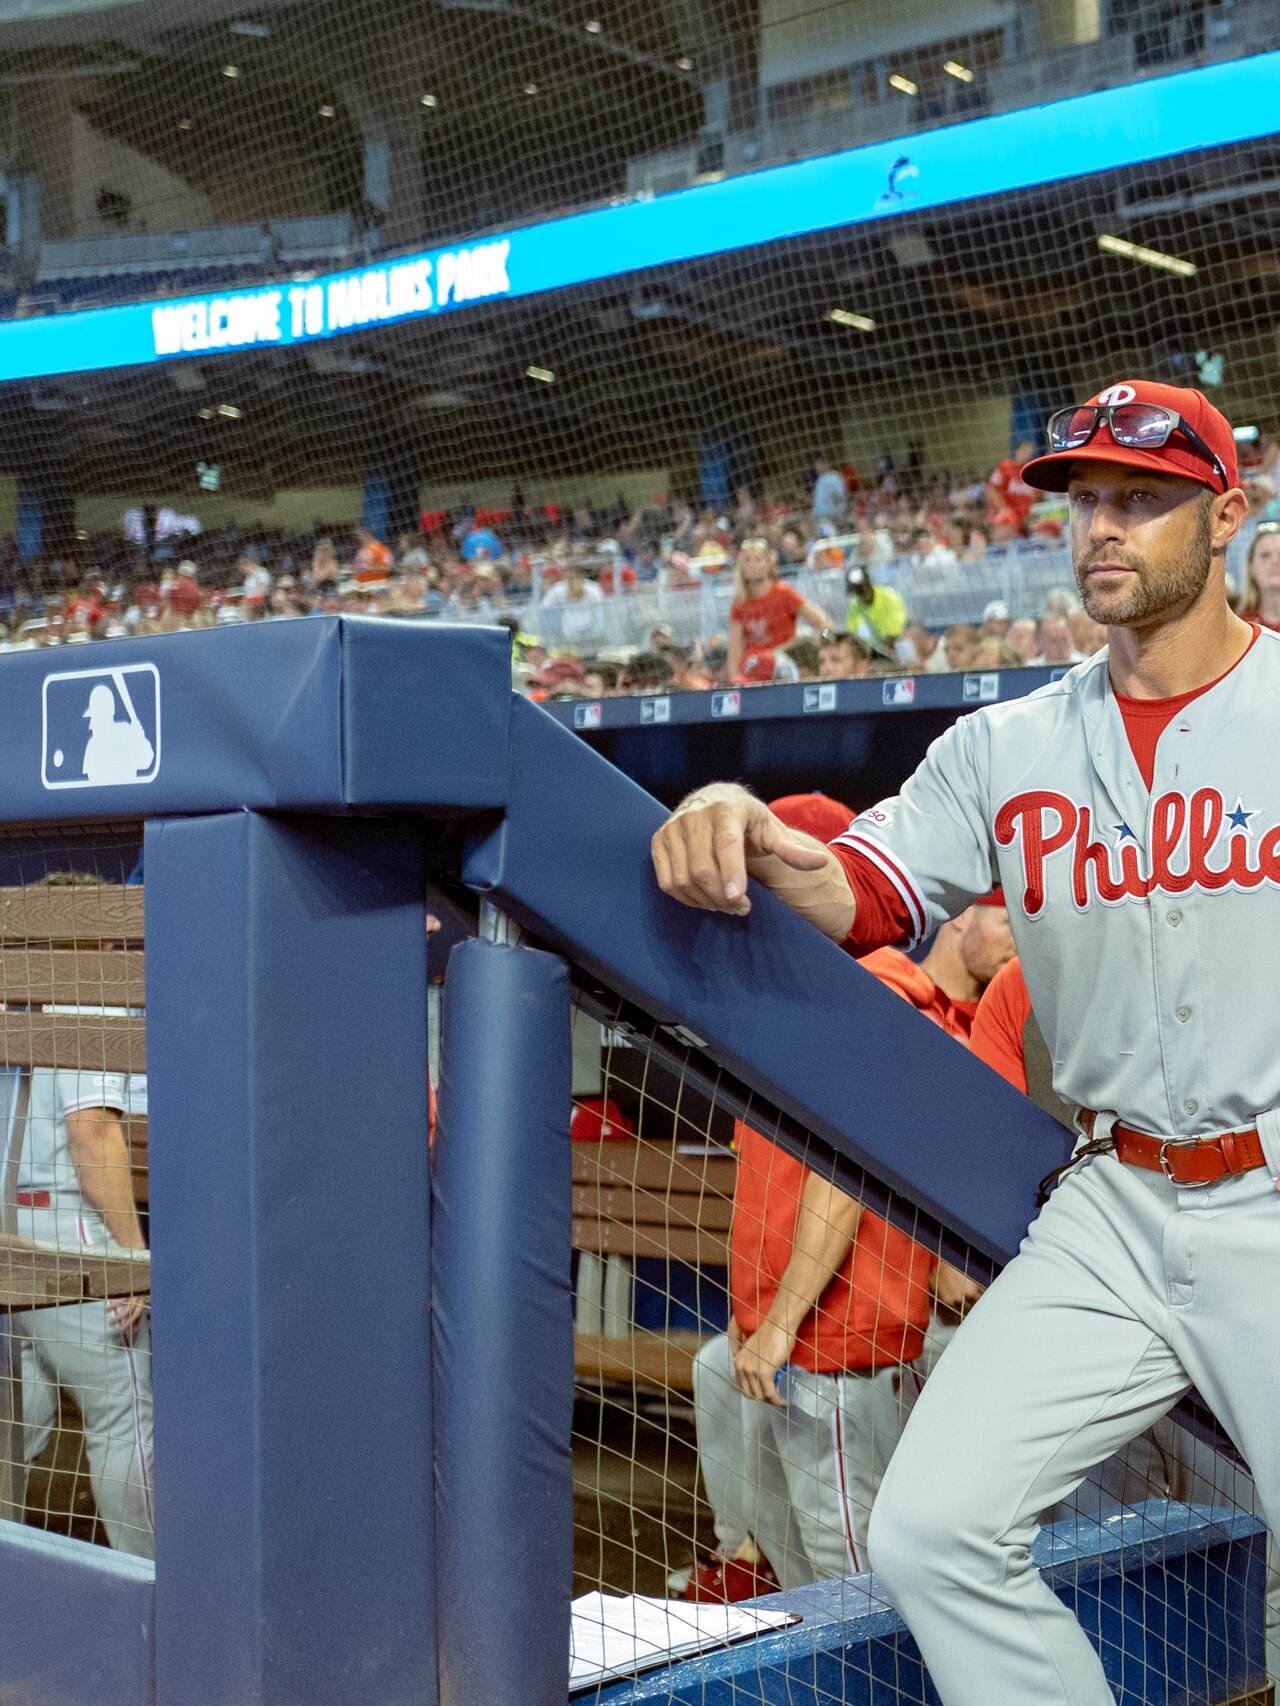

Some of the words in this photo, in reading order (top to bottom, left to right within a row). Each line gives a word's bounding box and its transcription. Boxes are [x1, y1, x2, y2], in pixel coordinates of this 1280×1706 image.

[152, 290, 282, 355] WELCOME
[287, 284, 323, 338] TO
[435, 239, 511, 306] PARK
